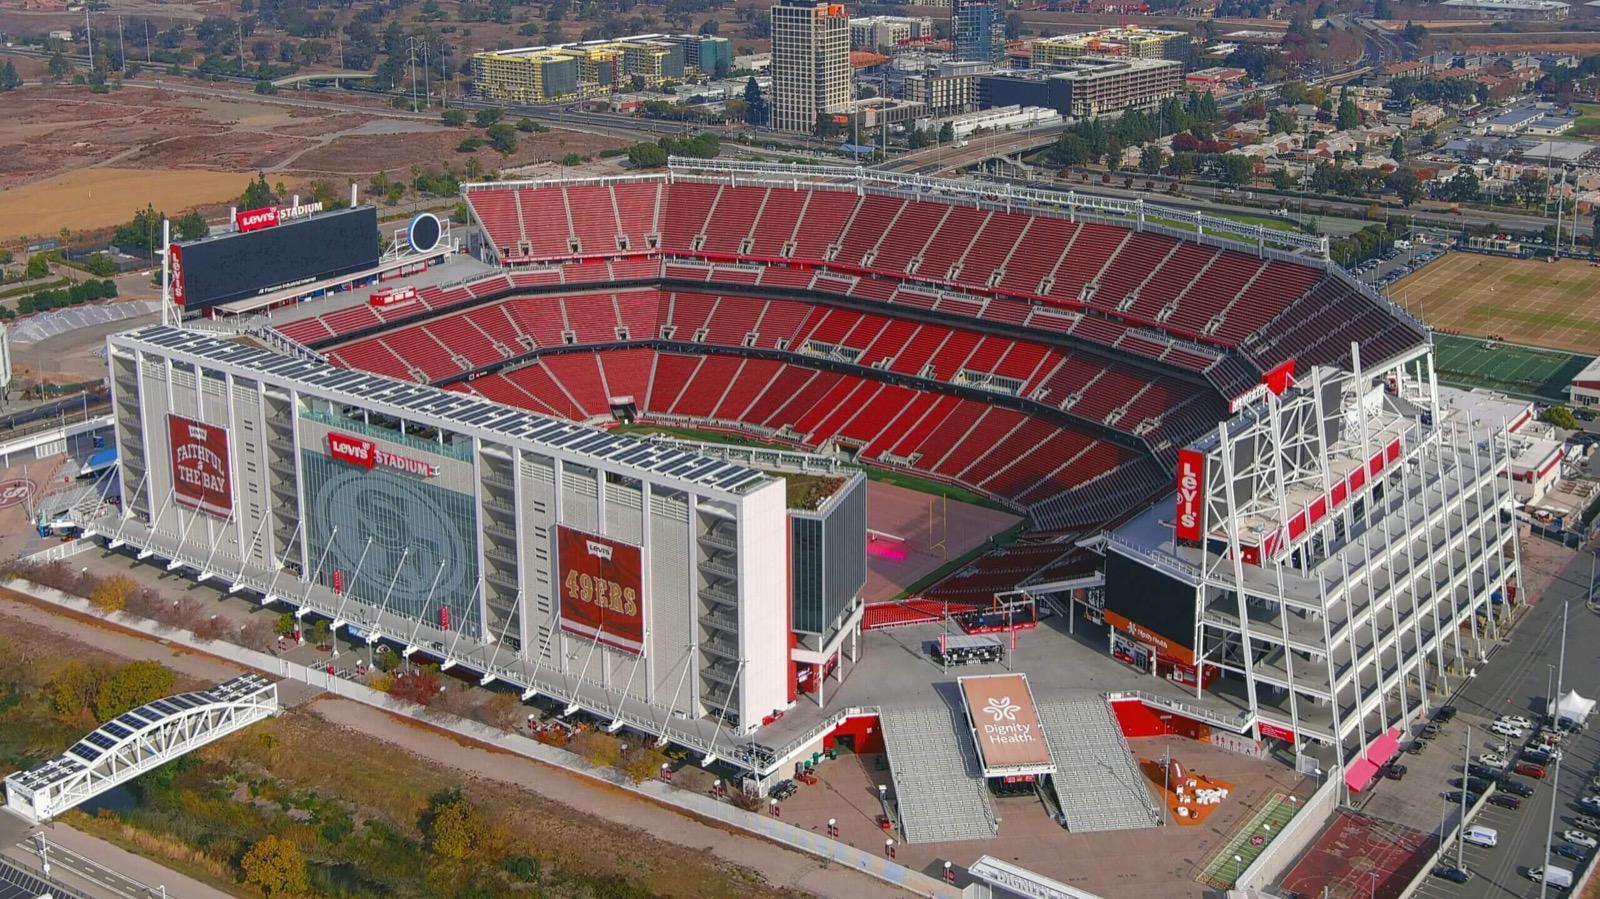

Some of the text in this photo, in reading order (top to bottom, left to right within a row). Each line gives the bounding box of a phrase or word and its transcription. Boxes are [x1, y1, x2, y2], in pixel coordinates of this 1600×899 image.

[280, 202, 323, 219] STADIUM
[177, 443, 225, 477] FAITHFUL
[376, 449, 429, 477] STADIUM
[178, 465, 225, 493] THE BAY
[565, 568, 637, 617] 49ERS
[984, 722, 1030, 735] Dignity
